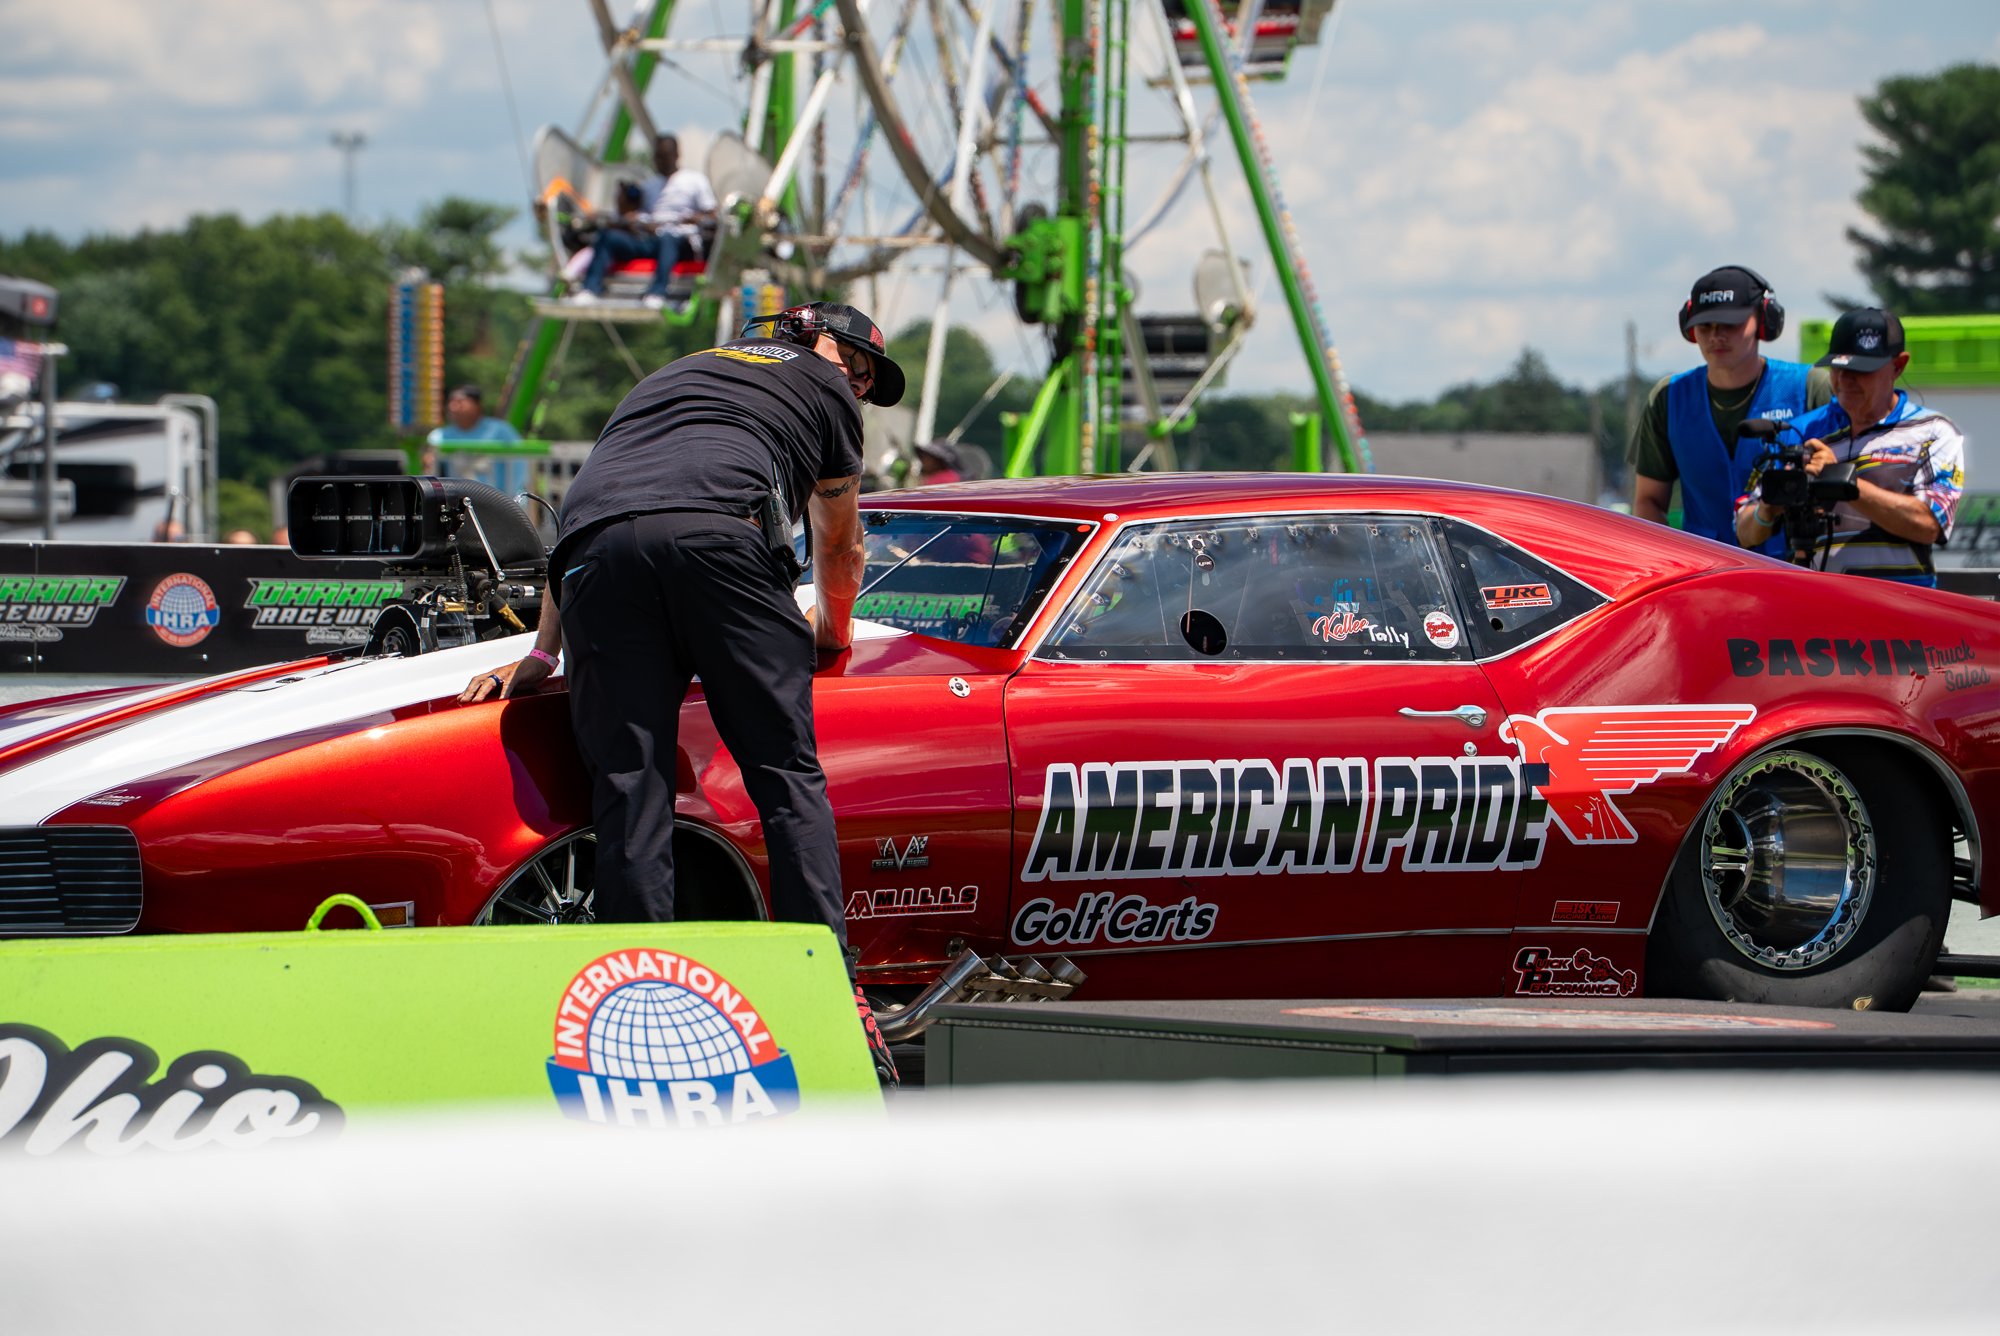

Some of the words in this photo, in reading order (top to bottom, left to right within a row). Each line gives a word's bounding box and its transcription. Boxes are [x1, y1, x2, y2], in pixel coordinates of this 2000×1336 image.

[1761, 408, 1794, 420] MEDIA
[0, 577, 121, 604] RANA
[155, 610, 209, 628] IHRA
[259, 607, 381, 624] RACEWA
[1363, 624, 1410, 649] Tally
[1727, 638, 1929, 677] BASKIN
[1925, 637, 1976, 668] Truck
[1944, 664, 1991, 692] Sales
[1021, 758, 1368, 881] AMERICAN
[1362, 757, 1549, 872] PRIDE
[1012, 892, 1114, 946] Golf
[1104, 895, 1219, 943] Carts
[1515, 969, 1620, 995] PERFORMANCE
[556, 951, 770, 1058] INTERNATIONAL
[577, 1071, 778, 1128] IHRA
